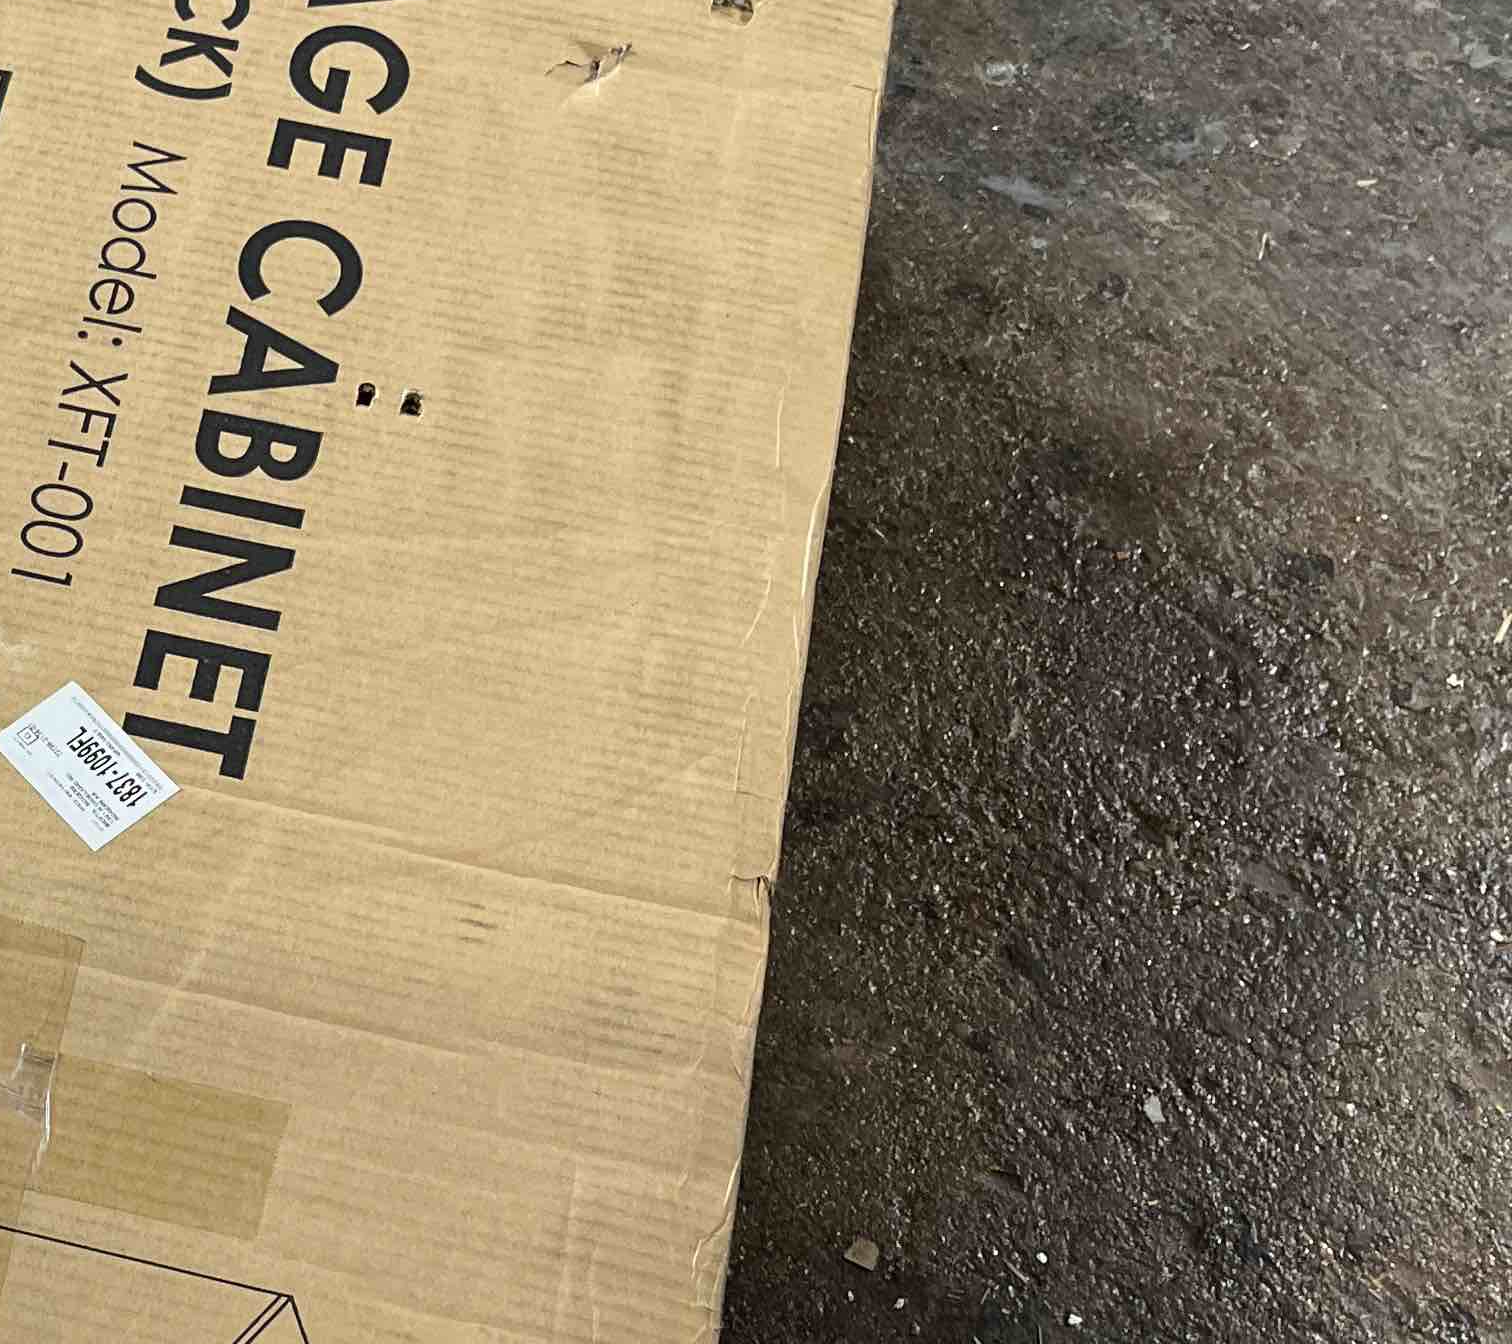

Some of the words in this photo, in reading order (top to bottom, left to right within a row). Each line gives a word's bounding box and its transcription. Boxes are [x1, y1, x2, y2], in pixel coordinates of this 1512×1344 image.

[77, 140, 187, 347] Model:
[10, 360, 129, 586] XFT-001
[122, 219, 363, 780] CABINET
[66, 726, 148, 807] 1837-1099FL
